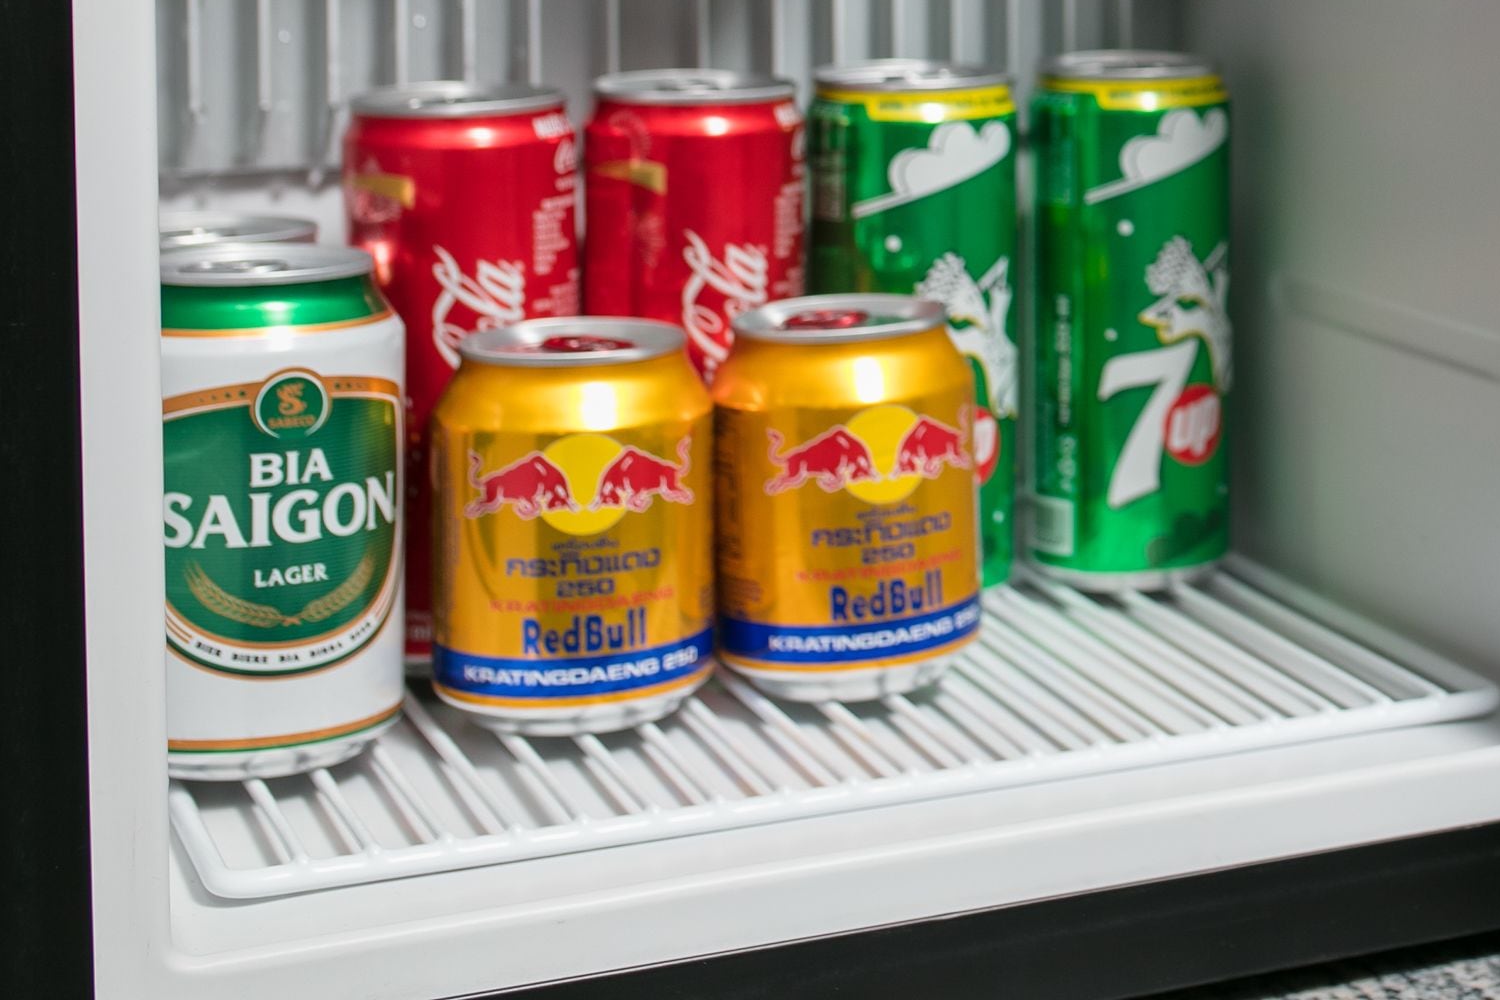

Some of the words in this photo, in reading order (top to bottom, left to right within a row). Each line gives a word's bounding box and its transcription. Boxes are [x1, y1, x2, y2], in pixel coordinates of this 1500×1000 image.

[249, 448, 334, 488] BIA
[163, 471, 395, 549] SAIGON
[254, 562, 329, 588] LAGER
[556, 578, 616, 598] 250
[767, 615, 953, 652] KRATINGDAENG
[463, 658, 660, 686] KRATINGDAENG
